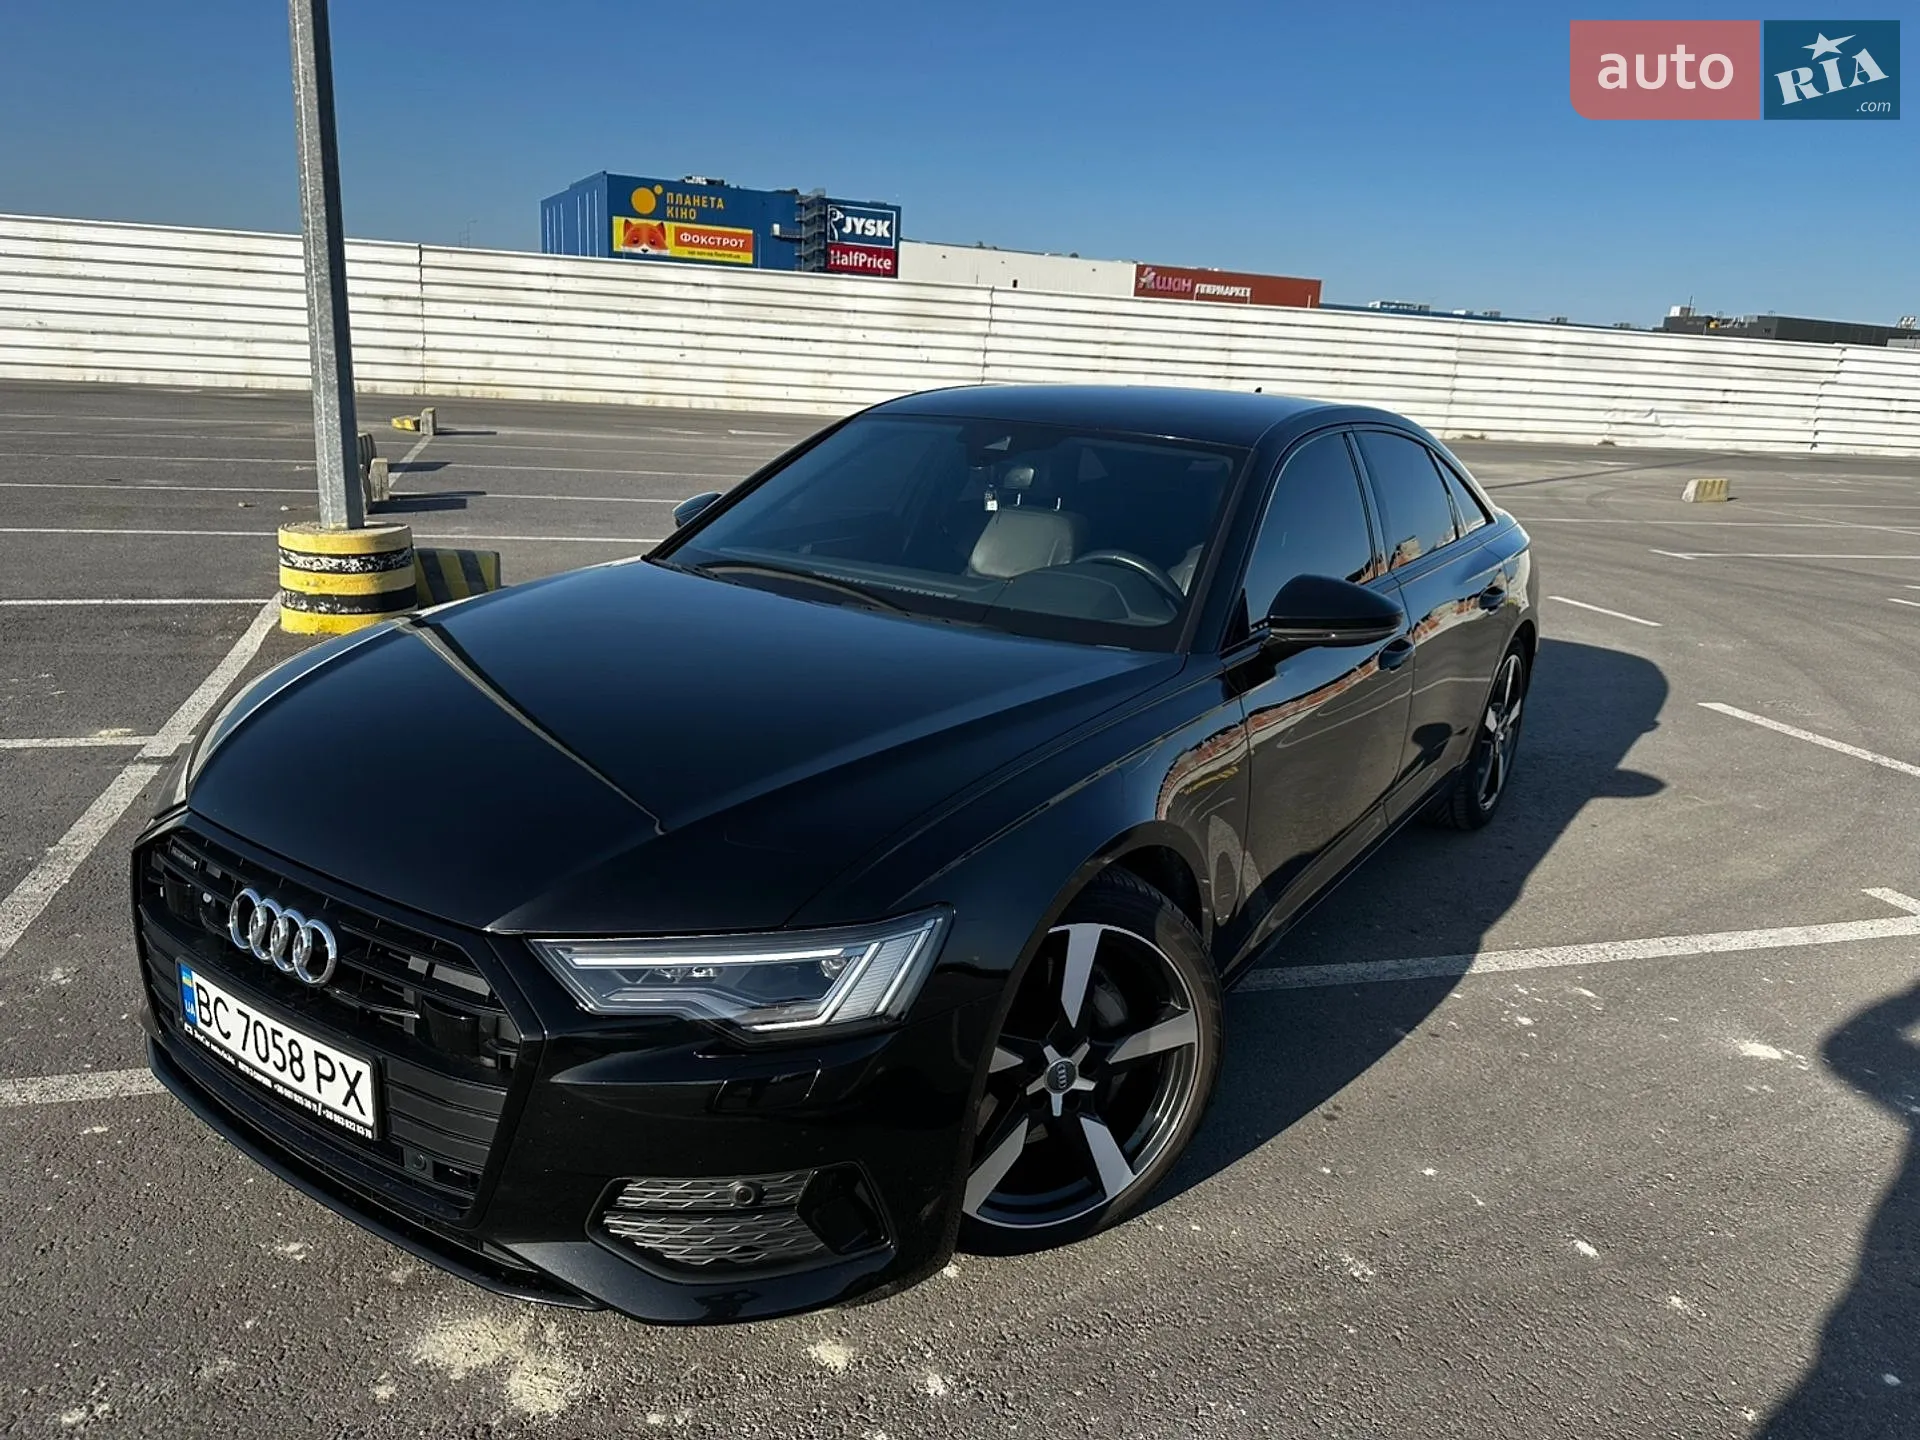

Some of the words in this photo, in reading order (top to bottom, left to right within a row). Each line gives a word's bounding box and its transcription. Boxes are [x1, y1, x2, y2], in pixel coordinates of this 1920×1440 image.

[666, 191, 725, 209] ПЛАНЕТА
[666, 205, 697, 220] КІНО
[842, 216, 891, 238] JYSK
[680, 232, 745, 248] ФОКСТРОТ
[830, 249, 892, 270] HalfPrice
[184, 1000, 196, 1017] UA
[195, 982, 231, 1040] BC
[236, 1008, 306, 1083] 7058
[314, 1050, 366, 1117] PX
